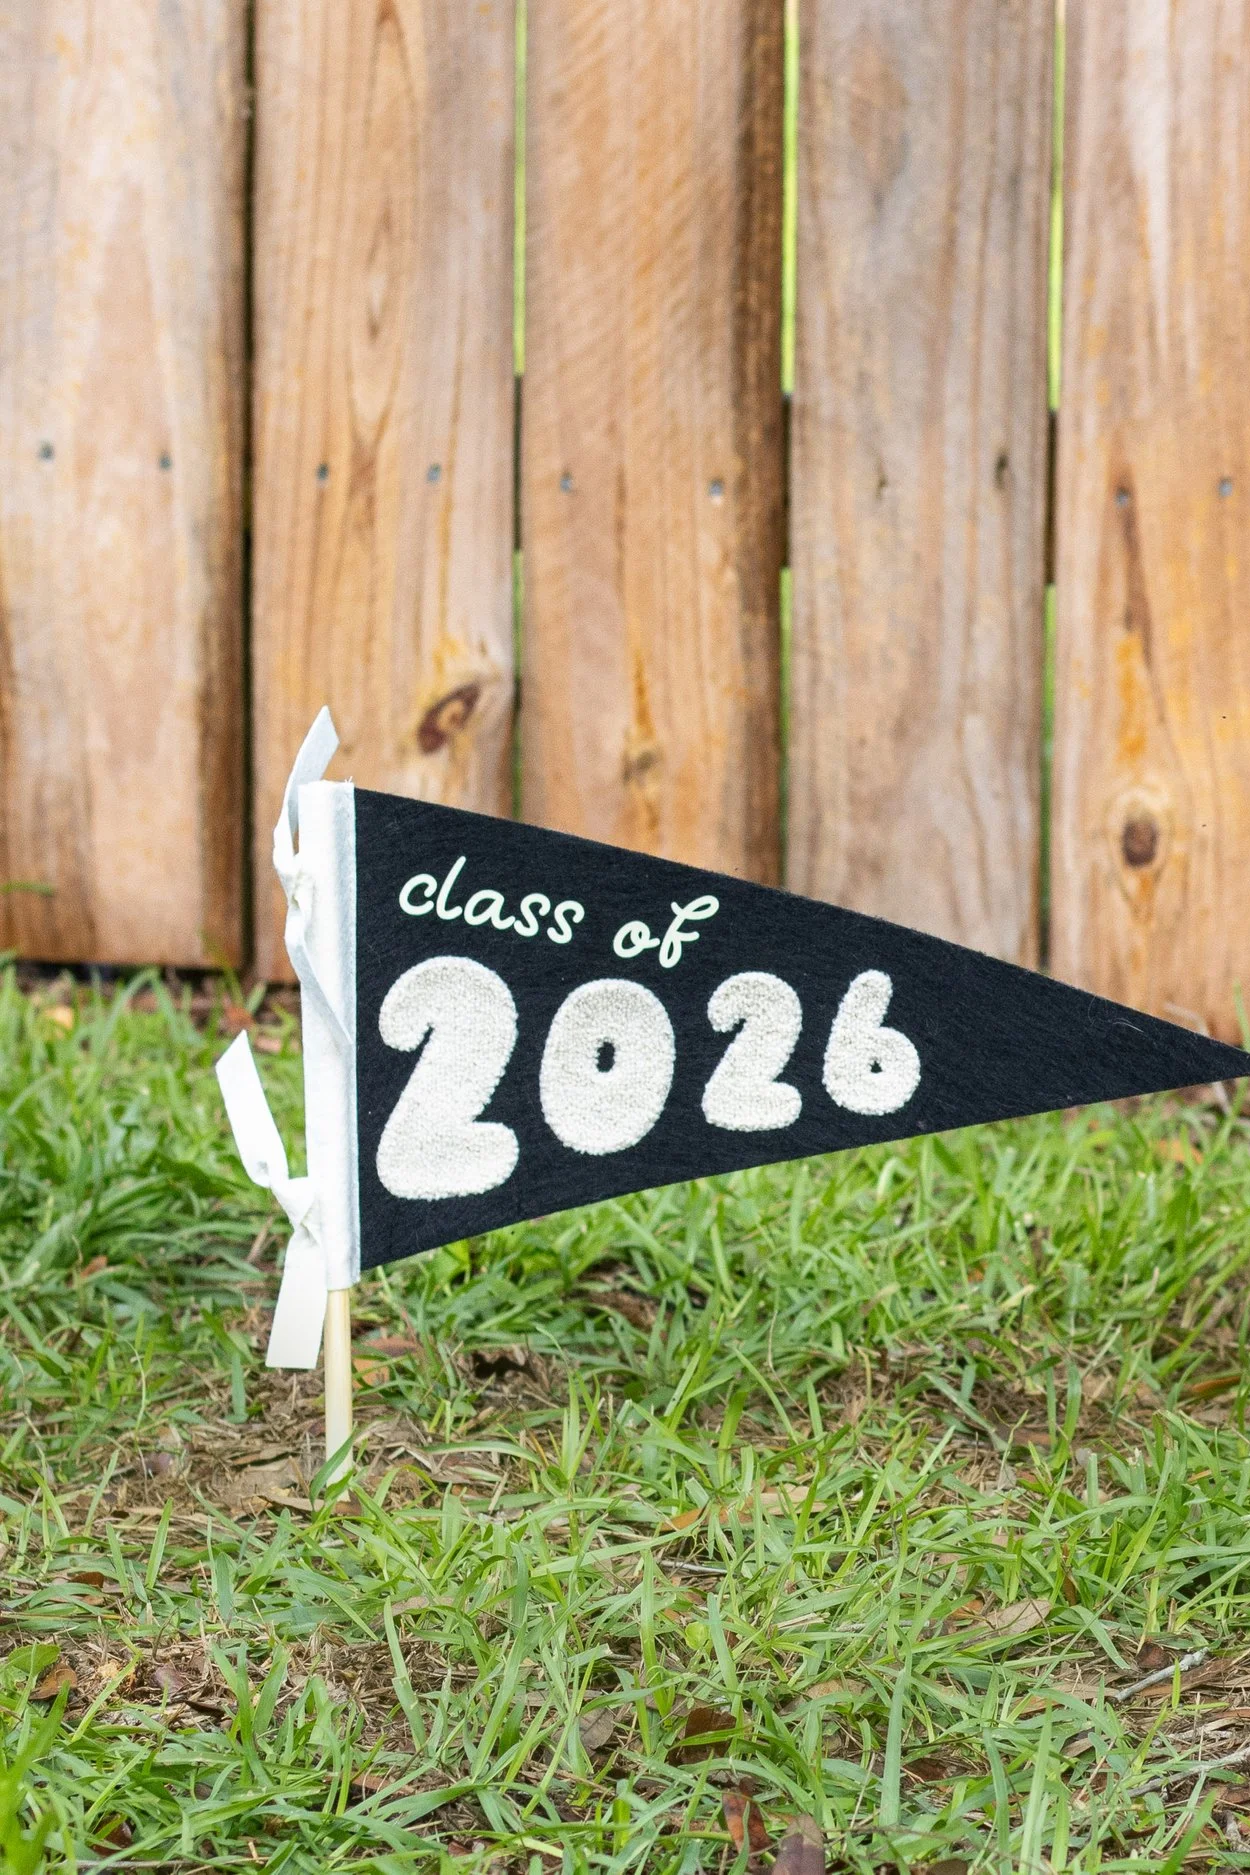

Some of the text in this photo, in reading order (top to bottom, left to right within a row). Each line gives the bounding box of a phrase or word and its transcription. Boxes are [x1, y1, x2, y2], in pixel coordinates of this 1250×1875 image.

[398, 856, 720, 969] class of
[375, 955, 922, 1202] 2026
